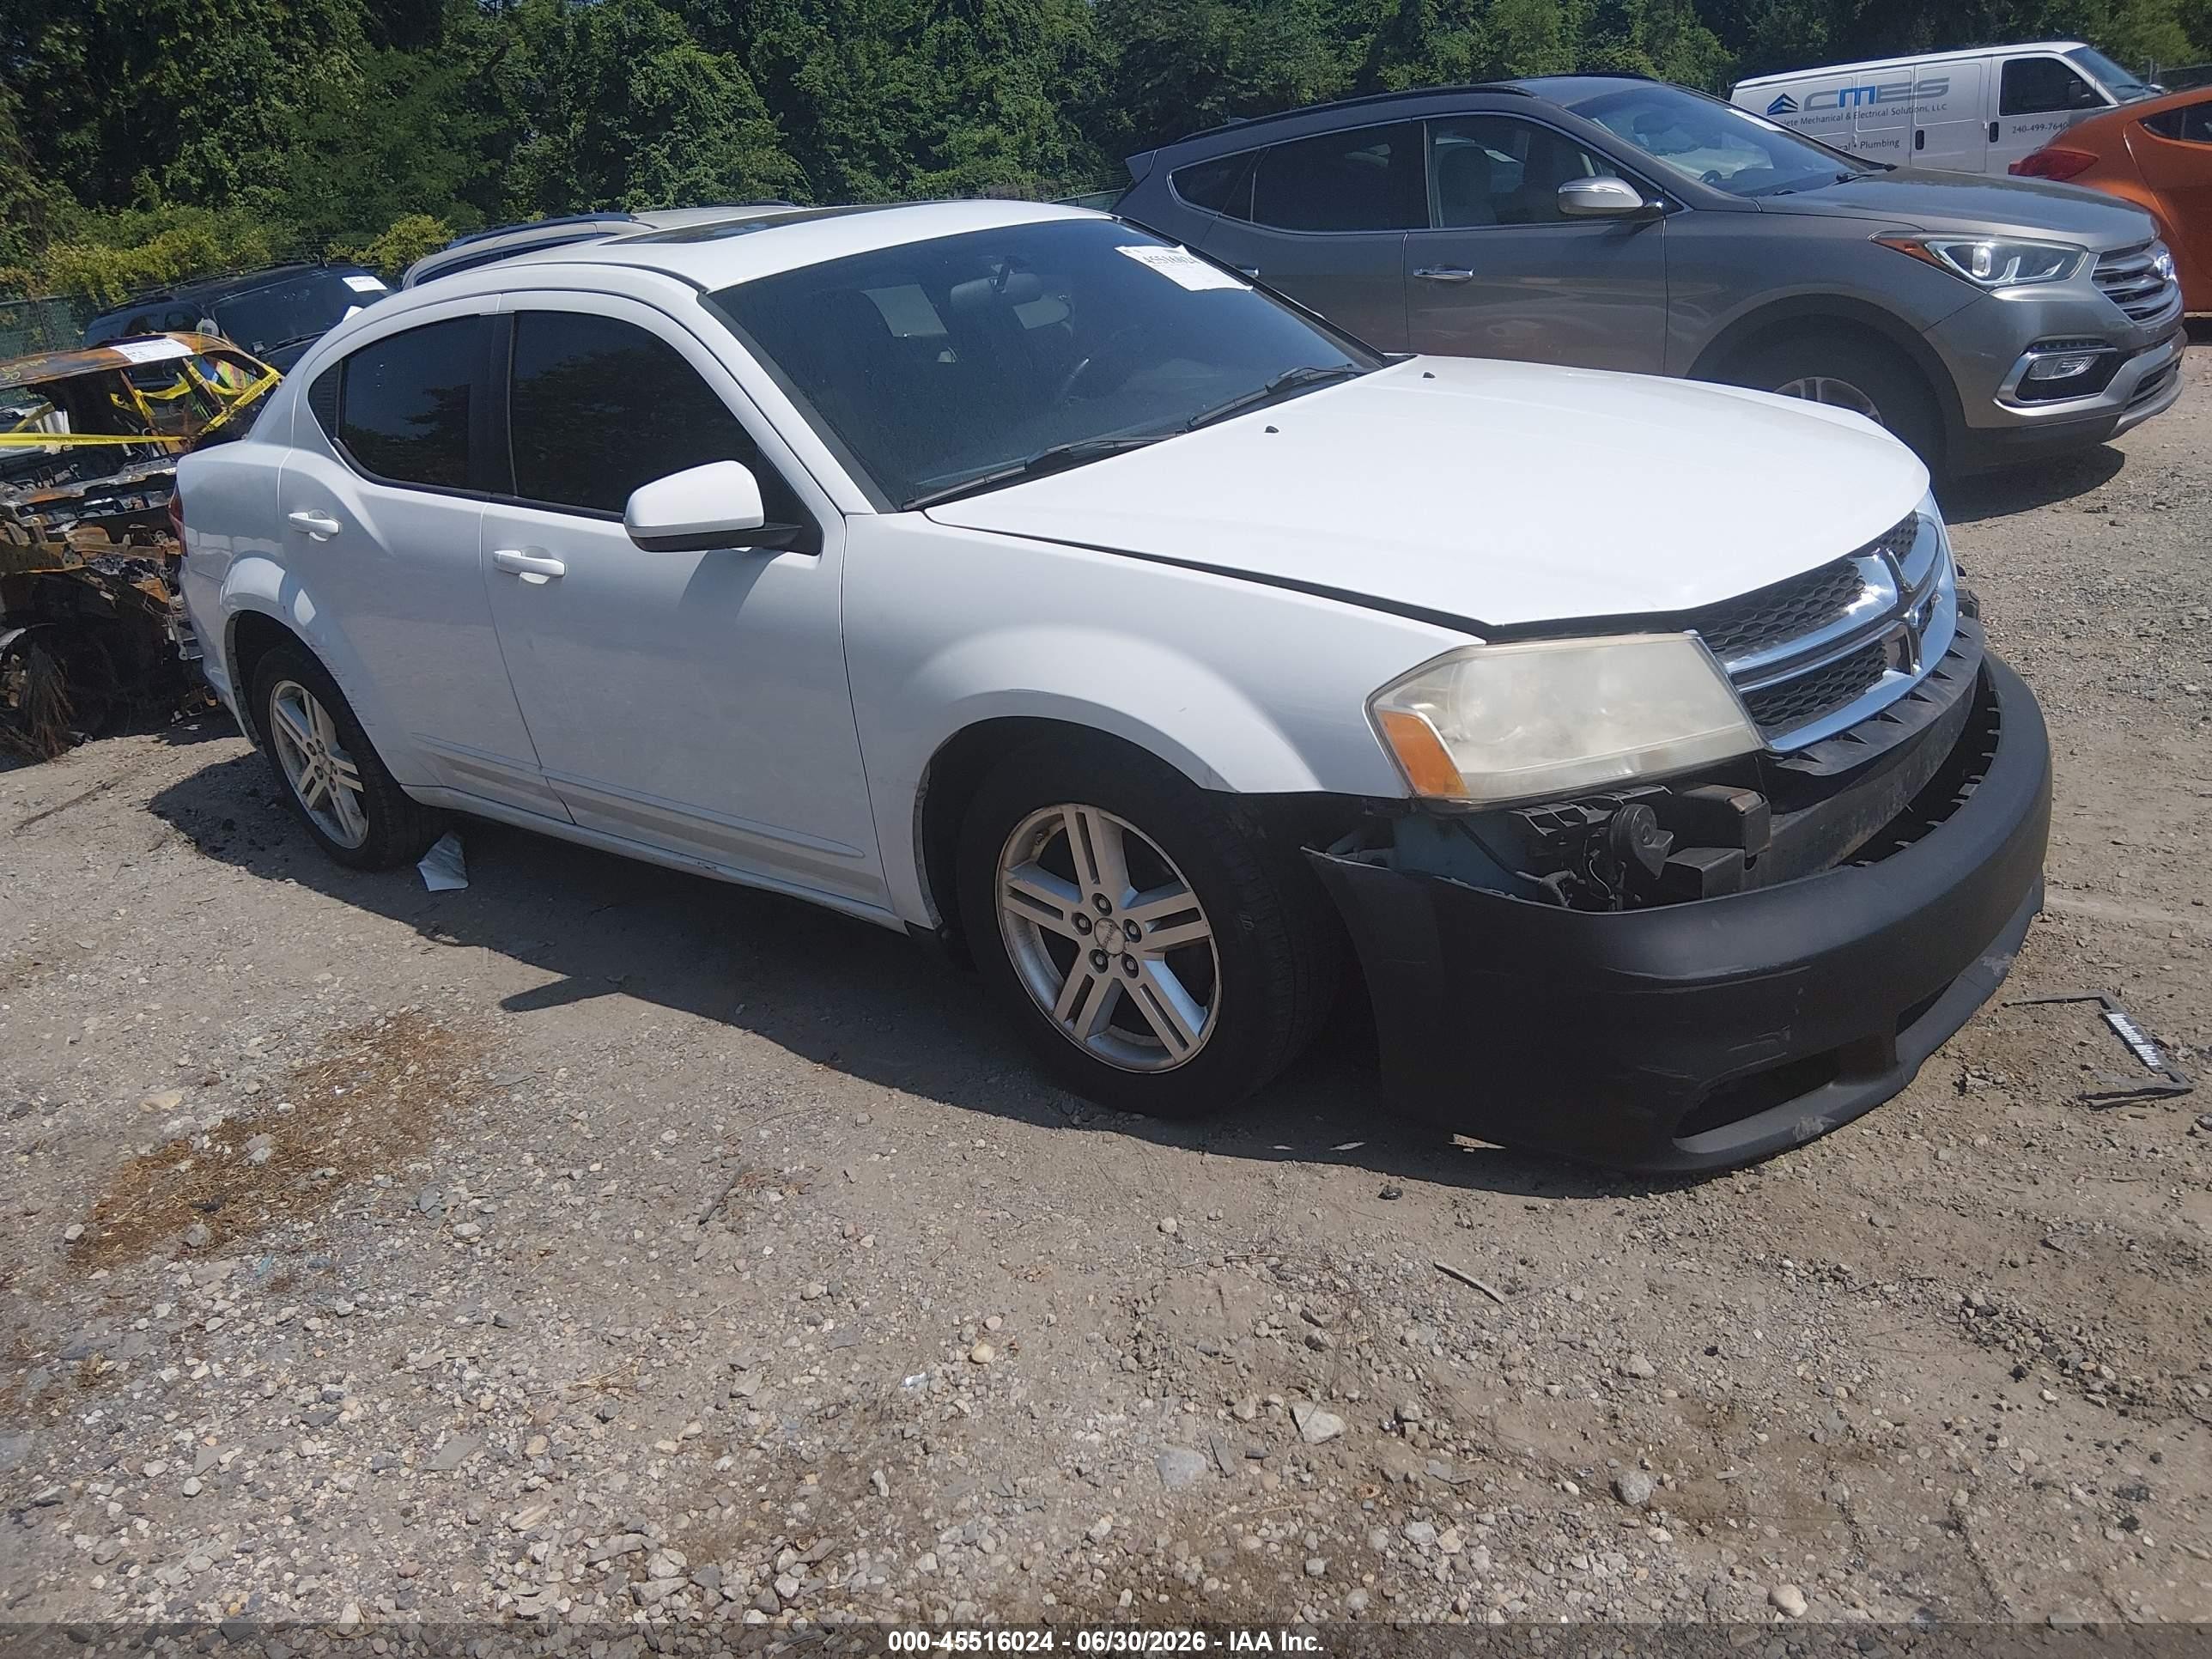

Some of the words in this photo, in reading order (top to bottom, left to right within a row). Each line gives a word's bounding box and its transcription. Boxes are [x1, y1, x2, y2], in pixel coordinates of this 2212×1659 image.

[1801, 113, 1843, 125] Mechanical
[1854, 109, 1888, 119] Electrical
[1932, 103, 1948, 112] LLC
[1860, 139, 1900, 149] Plumbing
